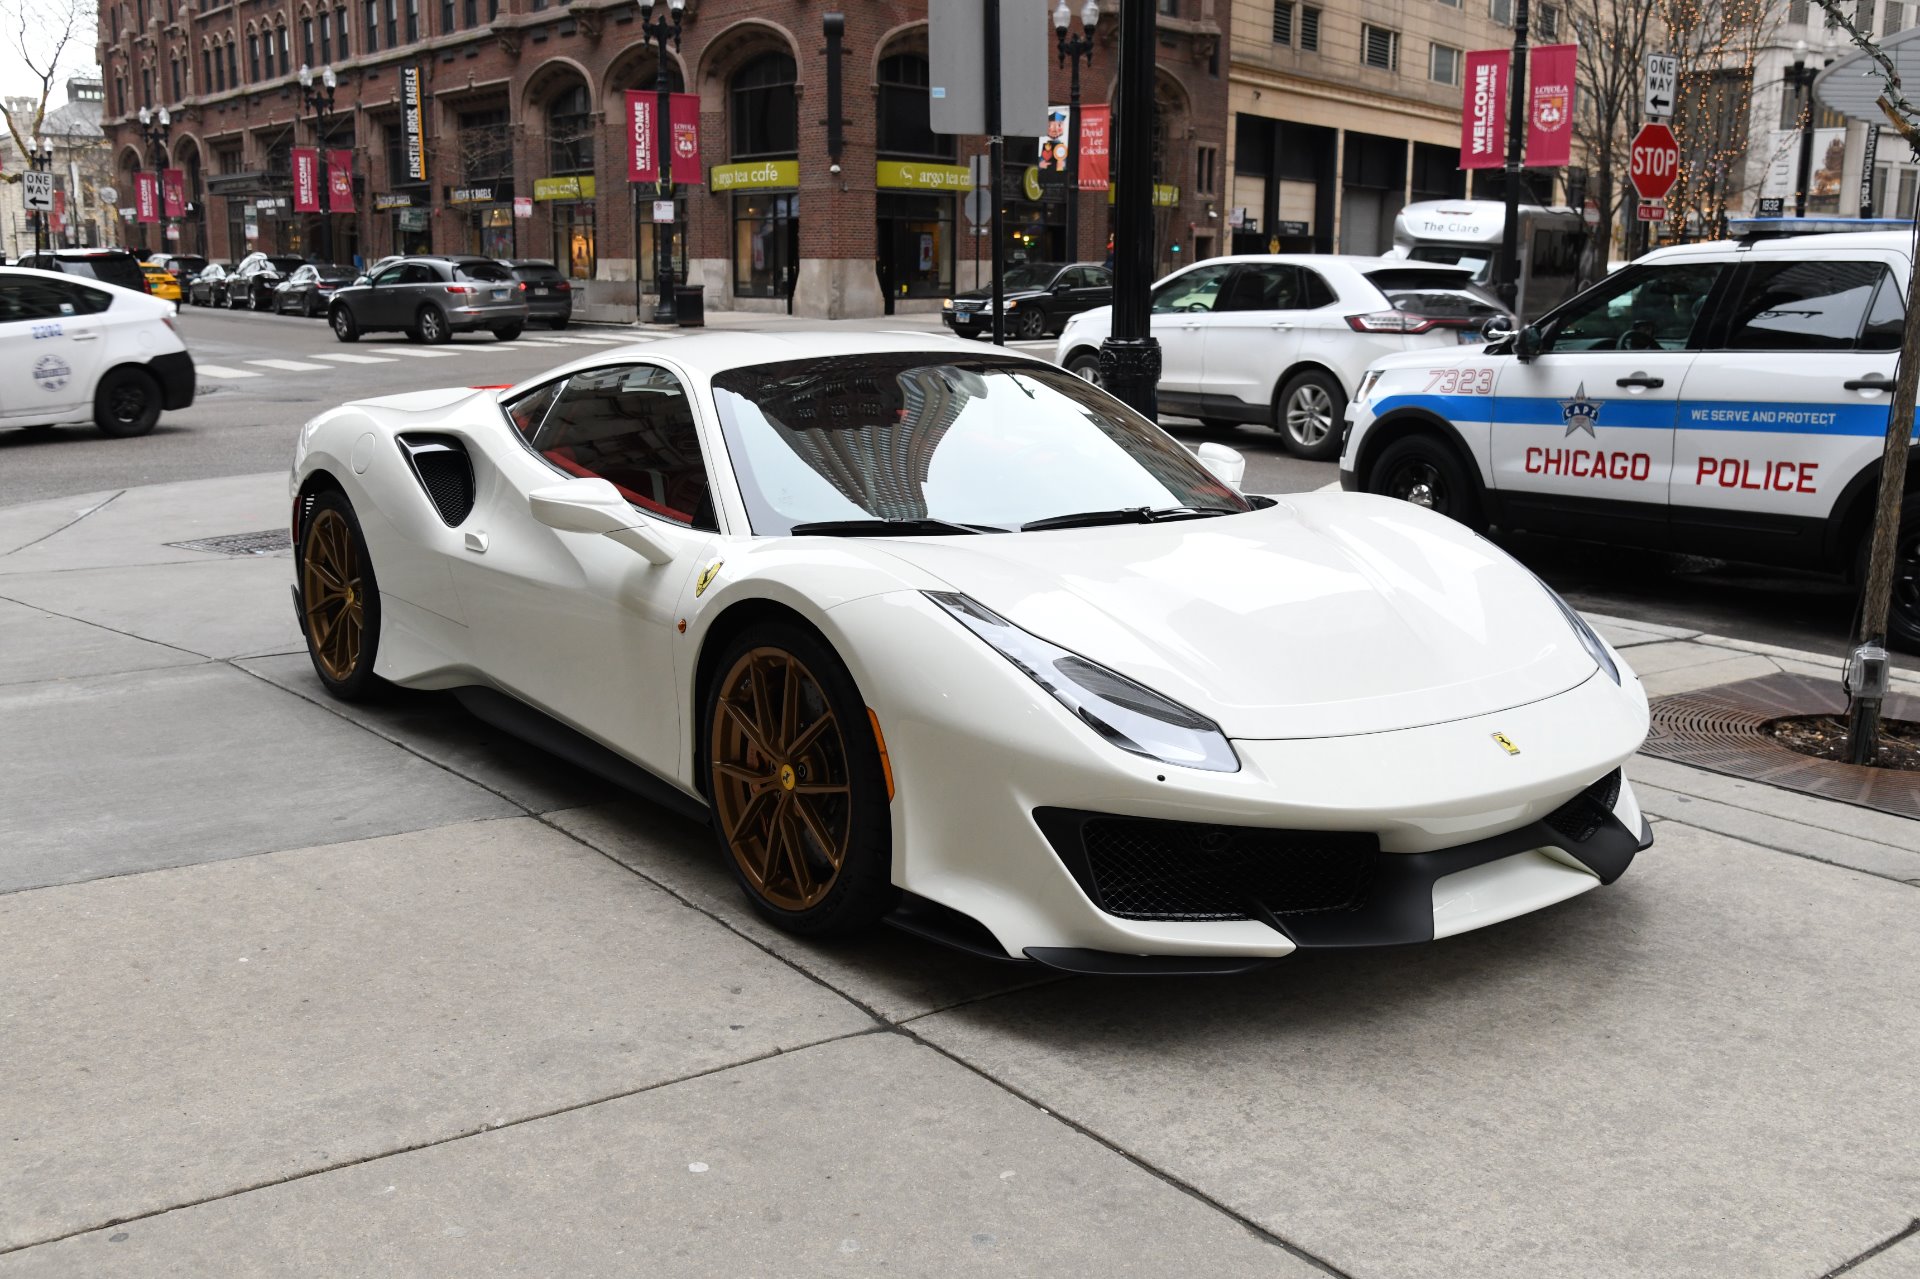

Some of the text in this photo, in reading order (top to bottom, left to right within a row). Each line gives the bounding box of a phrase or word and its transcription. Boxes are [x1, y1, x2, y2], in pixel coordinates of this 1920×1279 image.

[1650, 59, 1673, 76] ONE
[405, 68, 417, 105] BAGELS
[1534, 85, 1569, 95] LOYOLA
[1649, 76, 1673, 92] WAY
[1472, 64, 1490, 154] WELCOME
[1486, 64, 1498, 154] WATER TOWER CAMPUS
[634, 101, 645, 170] WELCOME
[409, 135, 421, 178] EINSTEIN
[1633, 146, 1677, 177] STOP
[735, 169, 748, 183] tea
[751, 163, 778, 182] café
[1860, 127, 1878, 208] ORDSTROM rack
[26, 173, 50, 186] ONE
[298, 156, 309, 204] WELCOME
[919, 171, 944, 188] argo
[945, 171, 959, 184] tea
[26, 185, 50, 196] WAY
[1640, 208, 1663, 218] ALL WAY
[1424, 222, 1480, 234] The Clare
[1422, 368, 1495, 394] 7323
[1565, 405, 1597, 418] CAPS
[1691, 409, 1836, 425] WE SERVE AND PROTECT
[1525, 446, 1819, 494] CHICAGO POLICE
